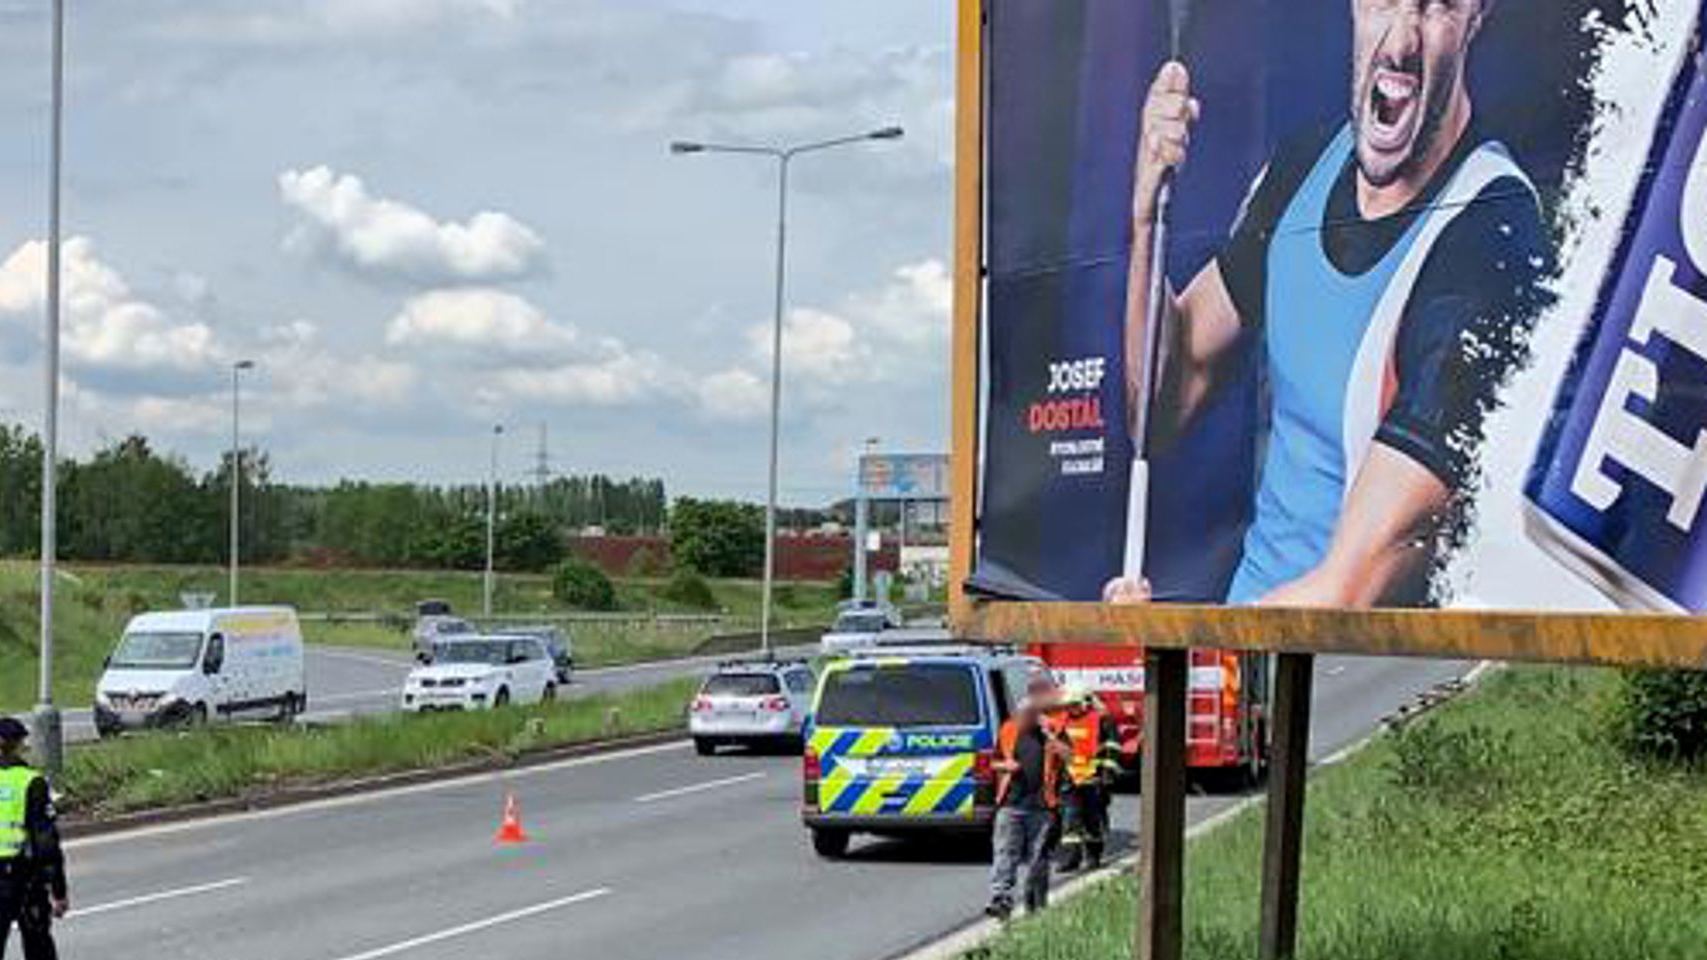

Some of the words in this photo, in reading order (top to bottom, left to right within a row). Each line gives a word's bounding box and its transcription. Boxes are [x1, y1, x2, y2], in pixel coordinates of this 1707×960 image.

[1570, 122, 1707, 533] TI
[1047, 358, 1105, 392] JOSEF
[906, 734, 973, 748] POLICIE
